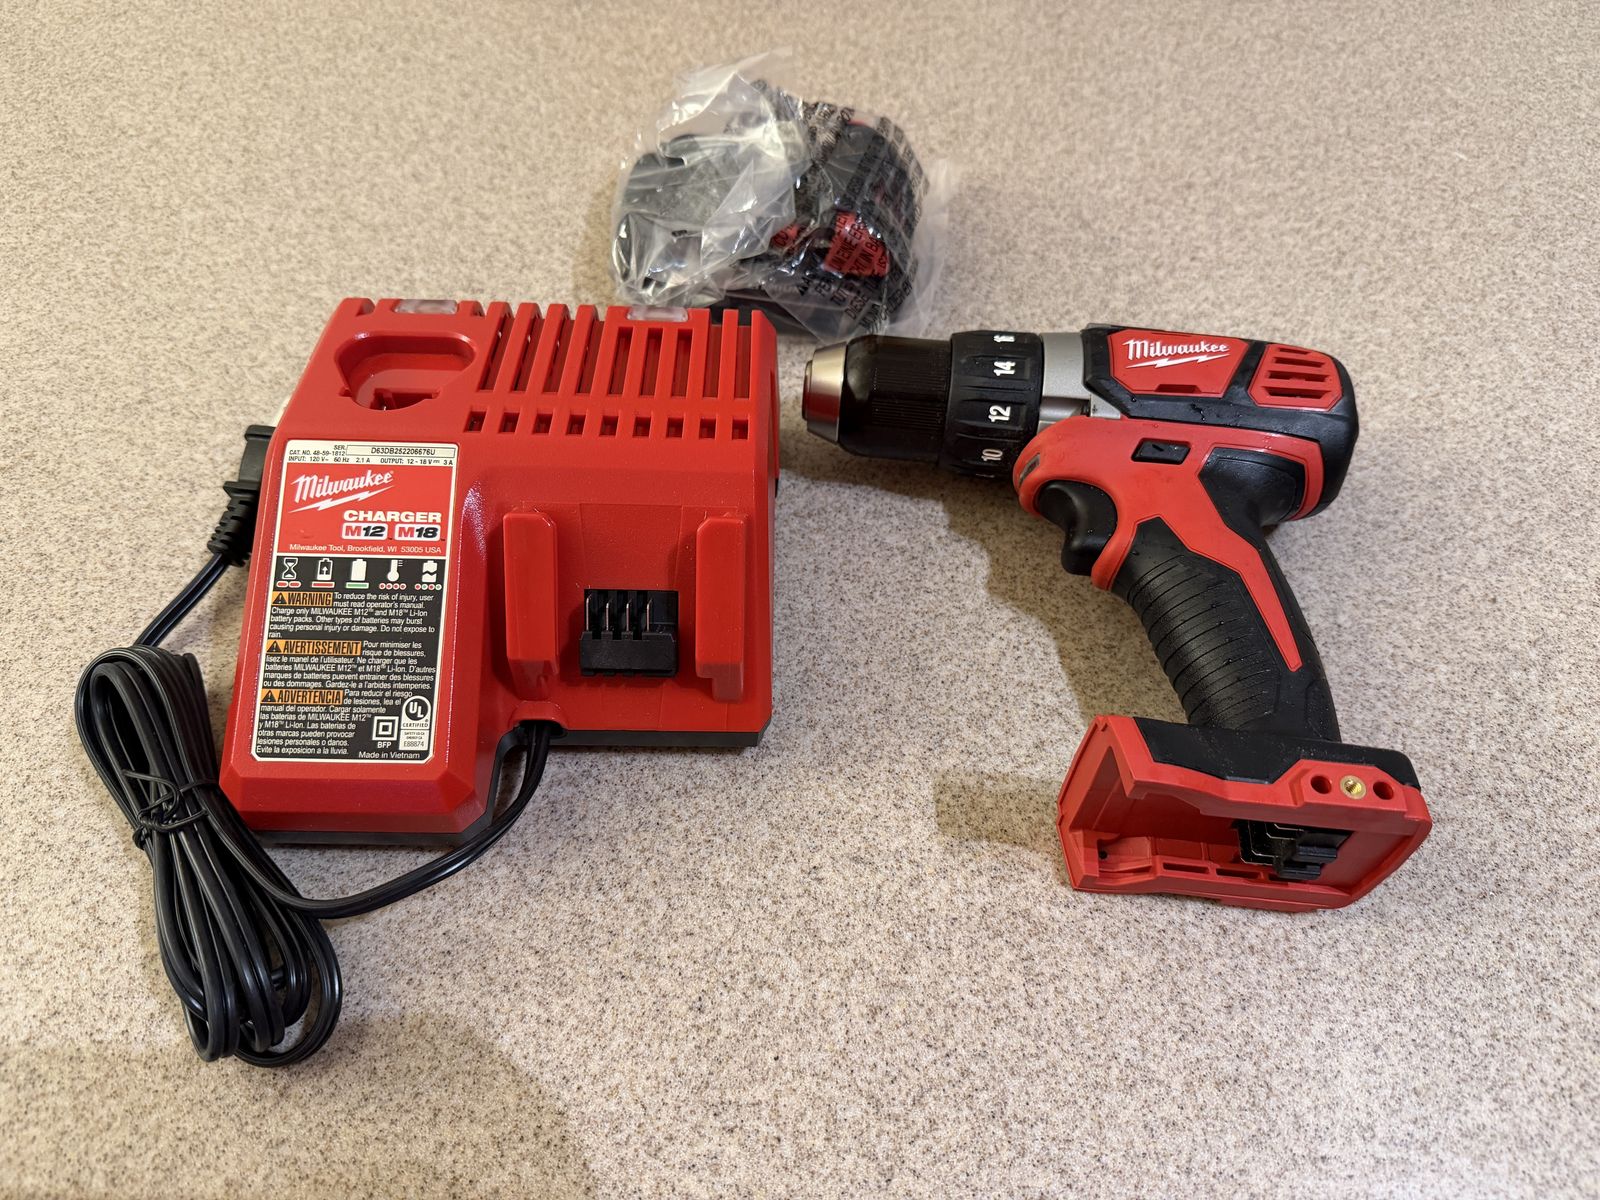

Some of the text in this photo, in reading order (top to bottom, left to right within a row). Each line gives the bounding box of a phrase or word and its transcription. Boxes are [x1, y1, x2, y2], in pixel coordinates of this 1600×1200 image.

[1121, 338, 1231, 360] Milwaukee
[994, 361, 1015, 376] 14
[988, 405, 1011, 422] 12
[981, 449, 1003, 461] 10
[290, 470, 394, 503] Milwaukee
[343, 510, 442, 523] CHARGER
[329, 544, 345, 552] Tool,
[400, 546, 424, 554] 53005
[425, 546, 442, 554] USA
[288, 592, 331, 606] WARNING
[399, 594, 418, 602] injury,
[366, 601, 398, 609] operator's
[271, 607, 295, 615] Charge
[296, 607, 310, 617] only
[271, 615, 292, 623] battery
[293, 616, 314, 624] packs.
[295, 624, 323, 632] personal
[324, 624, 341, 632] injury
[351, 625, 379, 633] damage.
[403, 626, 427, 634] expose
[283, 640, 361, 655] AVERTISSEMENT
[363, 640, 379, 648] Pour
[362, 649, 382, 658] risque
[367, 657, 393, 666] charger
[394, 658, 406, 666] que
[266, 663, 292, 671] batteries
[293, 663, 336, 671] MILWAUKEE
[264, 672, 292, 680] marques
[286, 681, 323, 689] dommages.
[277, 689, 341, 704] ADVERTENCIA
[344, 688, 359, 696] Para
[361, 689, 384, 697] reducir
[392, 690, 413, 699] riesgo
[353, 698, 381, 706] lesiones,
[297, 705, 327, 714] operador.
[329, 705, 351, 714] Cargar
[409, 701, 424, 718] UL
[307, 713, 350, 721] MILWAUKEE
[300, 730, 325, 738] pueden
[326, 731, 355, 739] provocar
[284, 738, 320, 746] personales
[359, 751, 379, 759] Made
